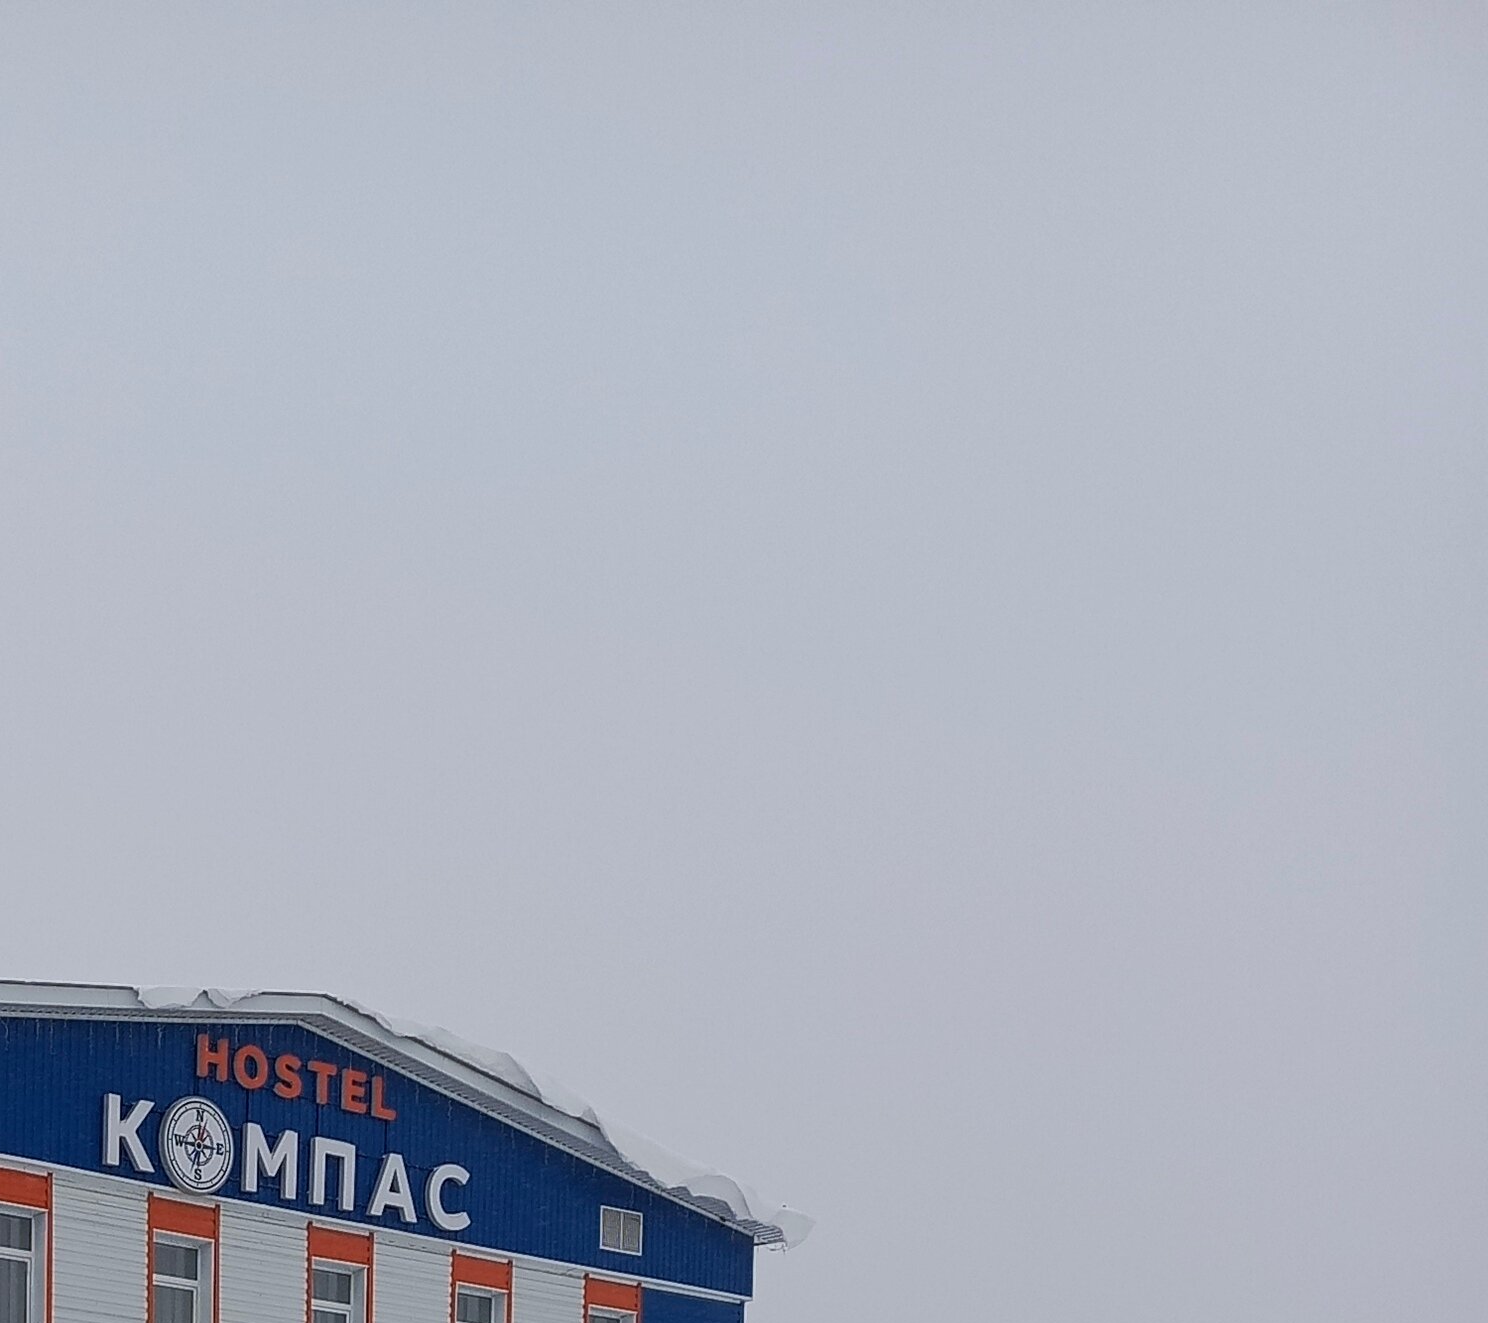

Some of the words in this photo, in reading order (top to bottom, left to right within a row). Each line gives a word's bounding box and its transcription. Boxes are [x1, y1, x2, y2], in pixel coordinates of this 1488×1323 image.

[196, 1033, 398, 1122] HOSTEL
[196, 1109, 205, 1122] N
[174, 1134, 186, 1147] W
[216, 1143, 224, 1155] E
[194, 1169, 202, 1180] S
